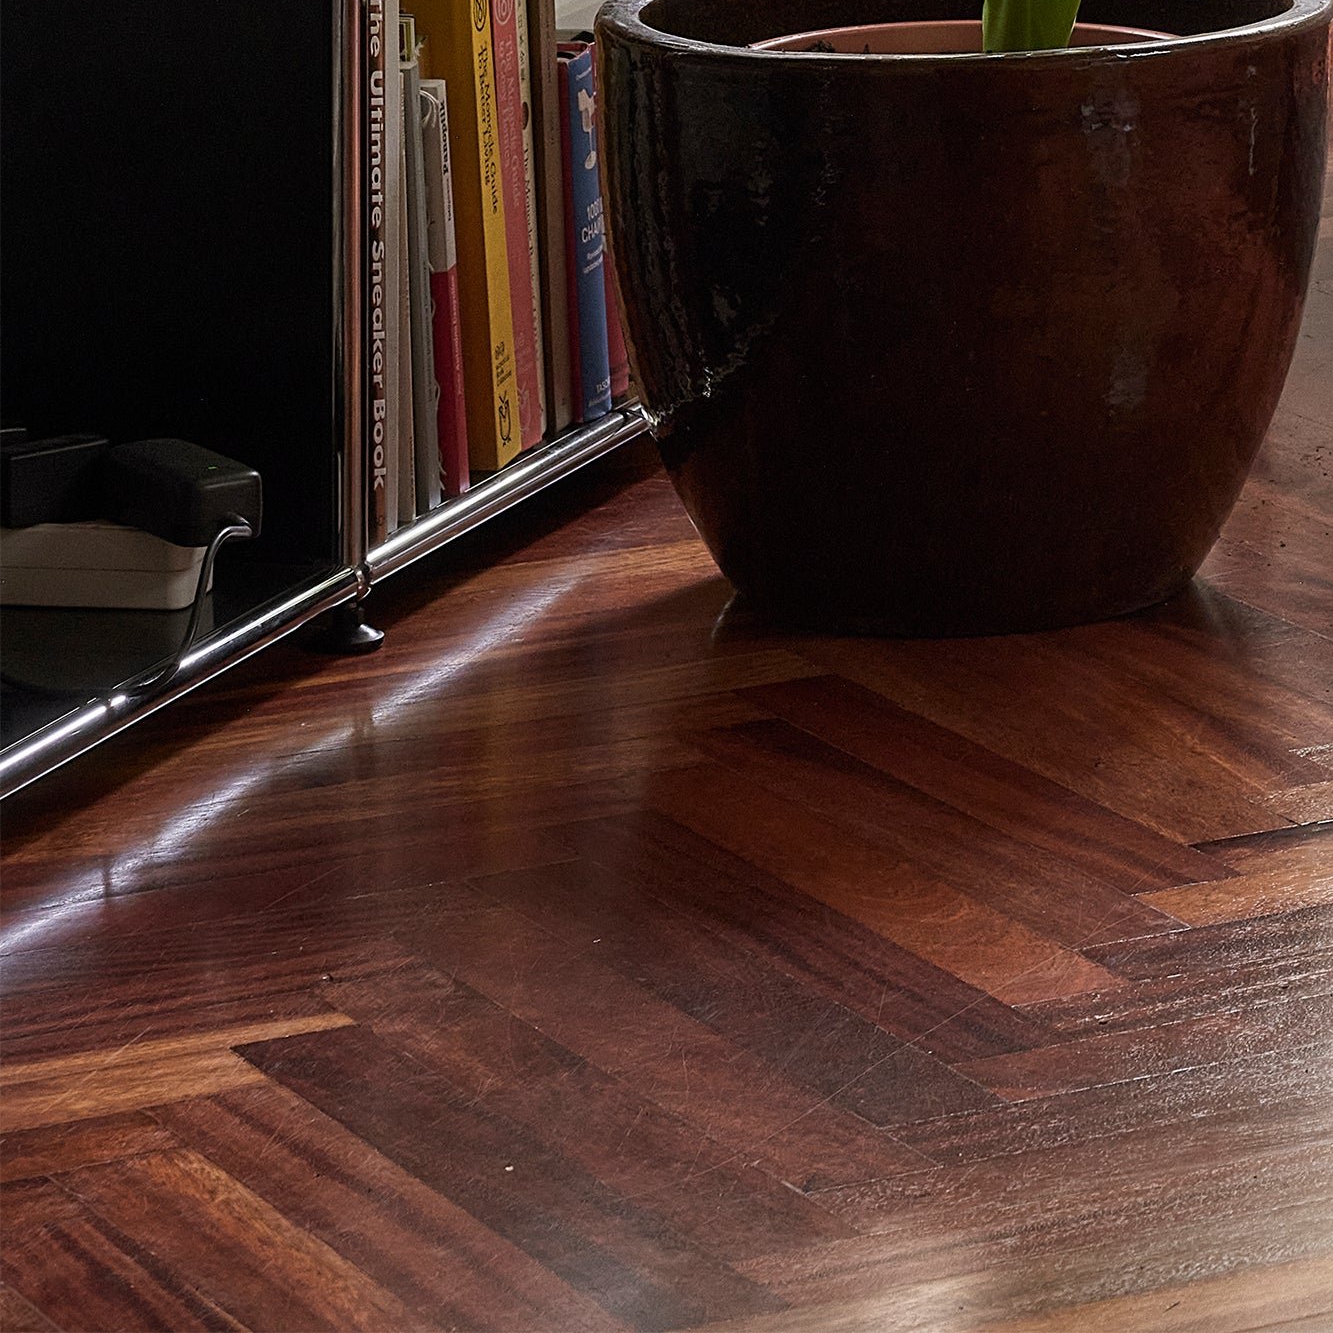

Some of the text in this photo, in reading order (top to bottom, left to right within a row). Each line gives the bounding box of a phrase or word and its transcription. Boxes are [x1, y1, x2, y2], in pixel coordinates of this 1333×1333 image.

[369, 69, 386, 231] Ultimate
[439, 99, 449, 175] Panoptik
[489, 160, 498, 215] Guide
[371, 238, 386, 392] Sneaker
[372, 396, 387, 491] Book
